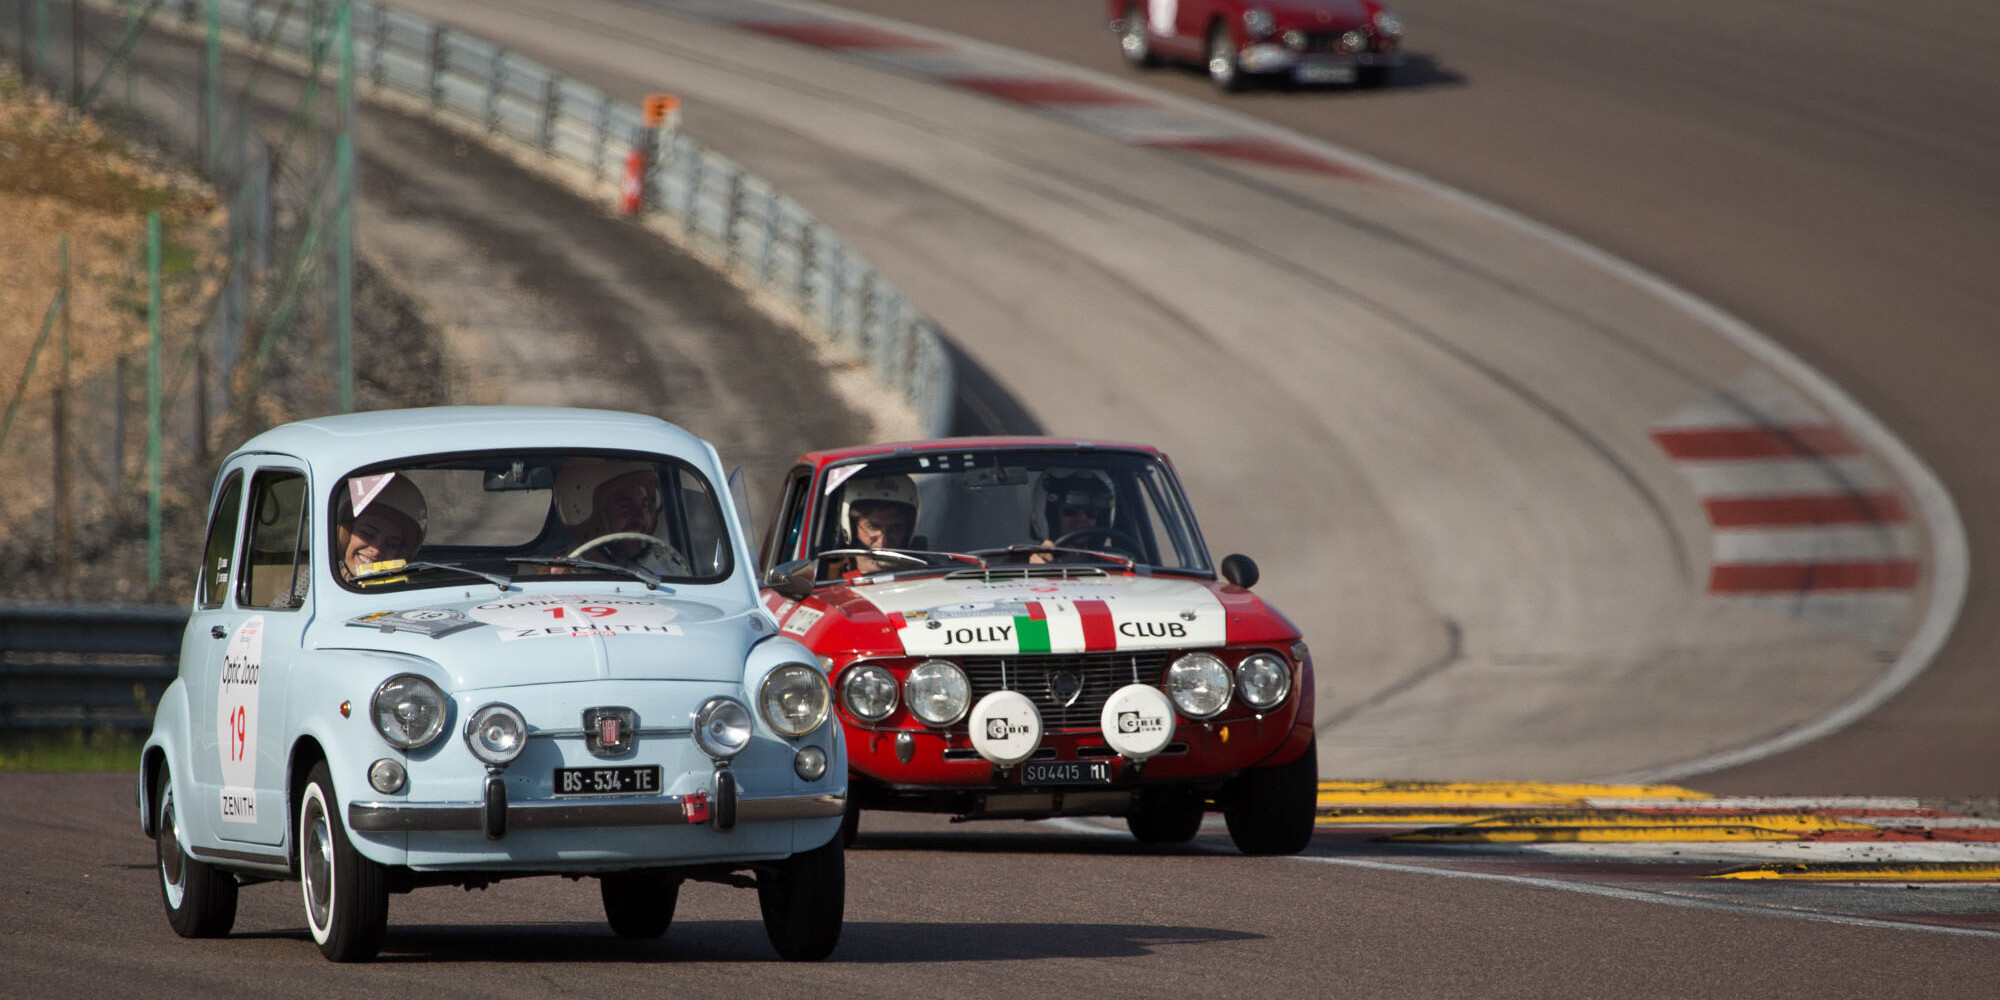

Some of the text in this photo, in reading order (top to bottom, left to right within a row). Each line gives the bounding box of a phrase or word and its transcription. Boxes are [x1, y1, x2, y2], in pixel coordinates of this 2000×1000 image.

[477, 598, 566, 609] Optic
[543, 606, 618, 618] 19
[516, 623, 669, 637] ZENITH
[944, 622, 1187, 645] JOLLY CLUB
[222, 654, 259, 694] Optic 2000
[230, 705, 245, 762] 19
[1090, 764, 1106, 780] MI
[223, 796, 254, 817] ZENITH
